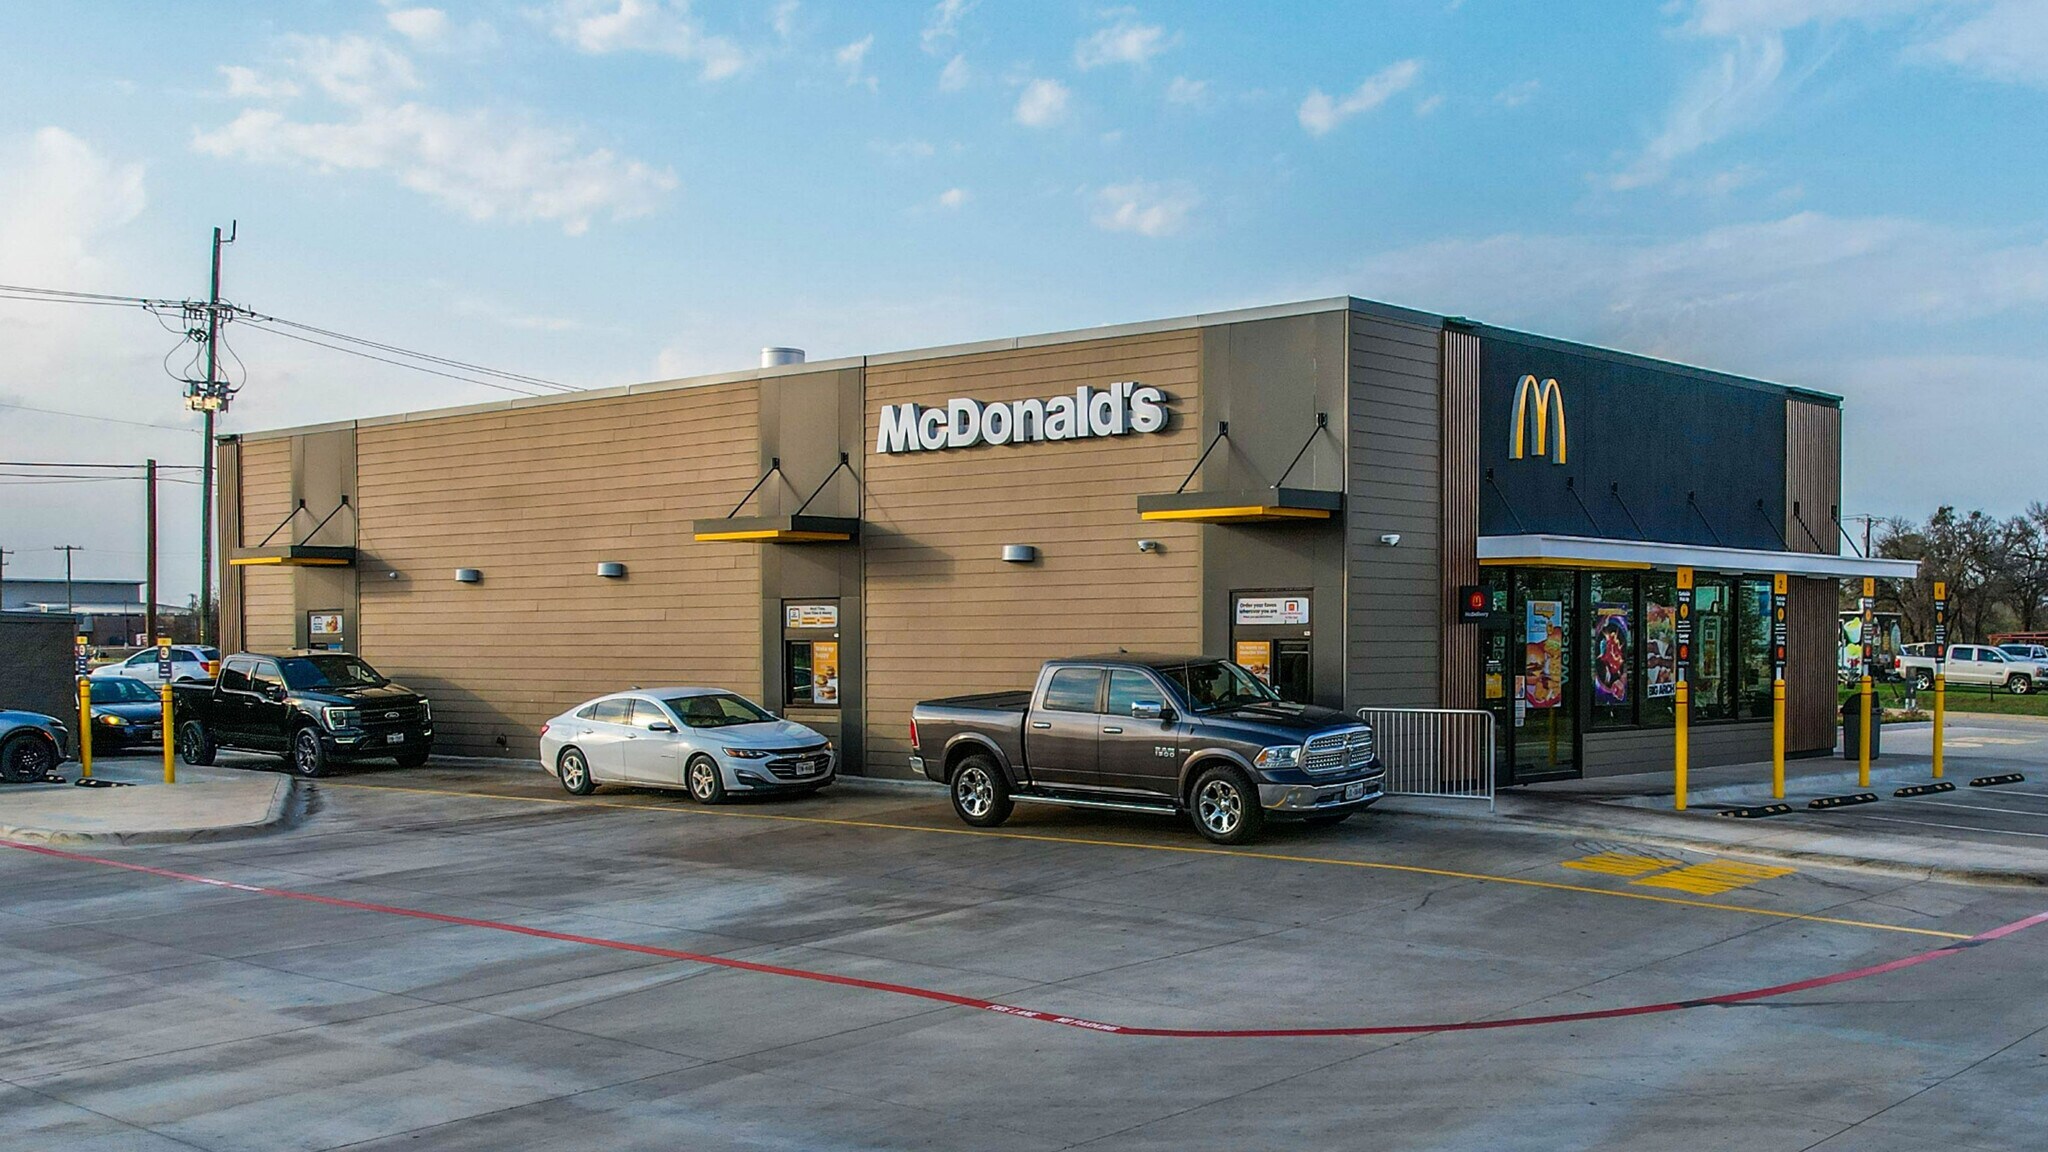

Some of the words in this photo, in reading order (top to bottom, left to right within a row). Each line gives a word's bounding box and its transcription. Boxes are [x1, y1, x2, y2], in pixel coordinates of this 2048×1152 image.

[876, 382, 1167, 453] McDonald's
[1560, 592, 1570, 686] Welcome
[1659, 683, 1675, 695] ARCH
